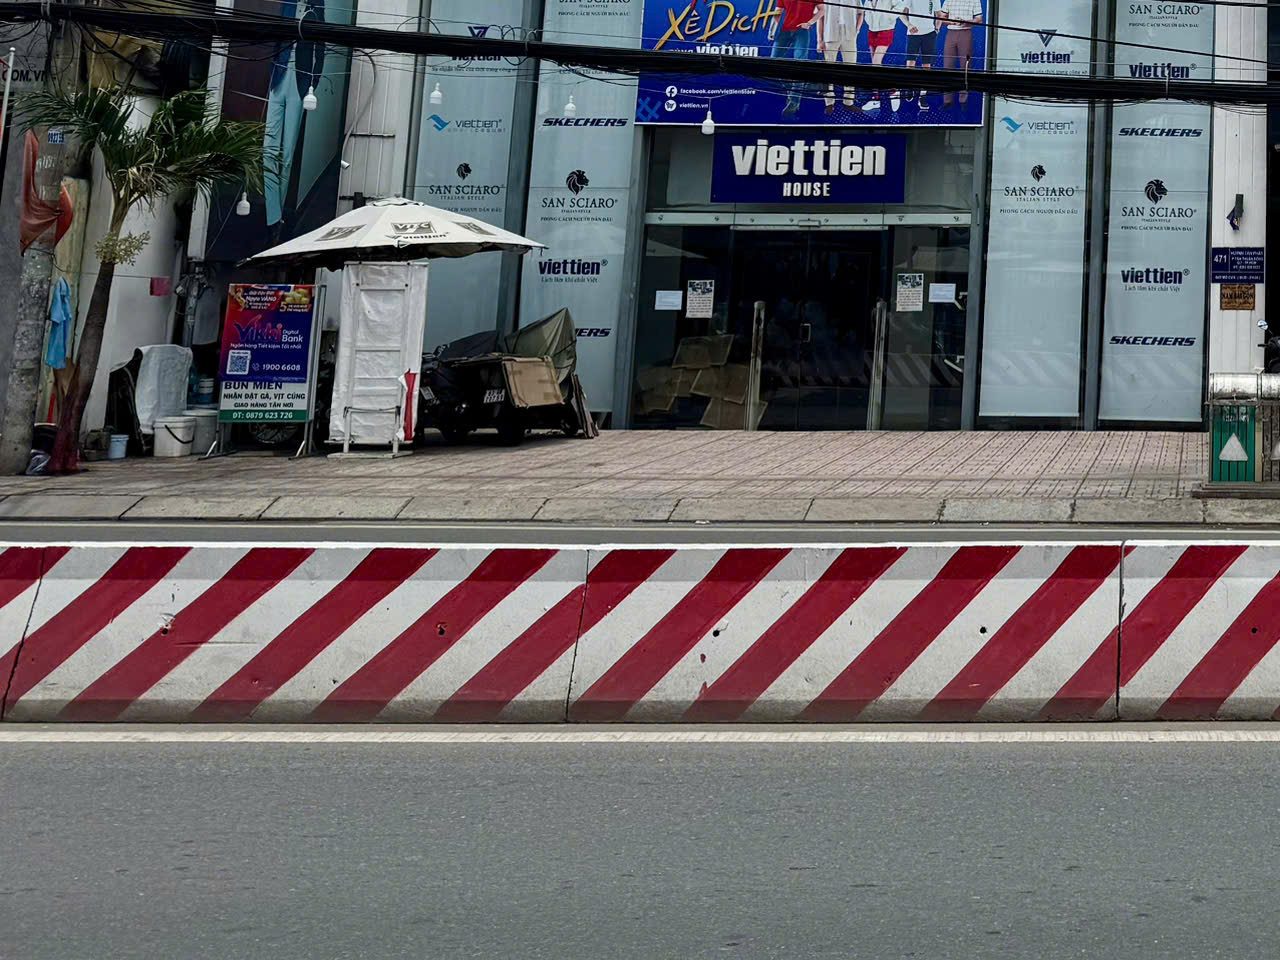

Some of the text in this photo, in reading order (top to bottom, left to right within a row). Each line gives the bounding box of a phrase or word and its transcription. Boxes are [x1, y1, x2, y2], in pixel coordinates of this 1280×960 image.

[1129, 4, 1200, 15] SAN SCIARO
[1021, 51, 1070, 64] viettien
[1129, 62, 1189, 78] viettien
[542, 118, 628, 126] SKECHERS
[1118, 127, 1203, 137] SKECHERS
[732, 139, 886, 176] viettien
[429, 184, 500, 195] SAN SCIARO
[783, 182, 830, 197] HOUSE
[1004, 186, 1075, 197] SAN SCIARO
[541, 198, 614, 209] SAN SCIARO
[1121, 206, 1194, 218] SAN SCIARO
[1213, 254, 1227, 263] 471
[538, 259, 600, 275] viettien
[1121, 267, 1183, 284] viettien
[281, 334, 303, 343] Bank
[1109, 336, 1196, 347] SKECHERS
[281, 364, 301, 372] 6608
[274, 393, 285, 401] VỊT
